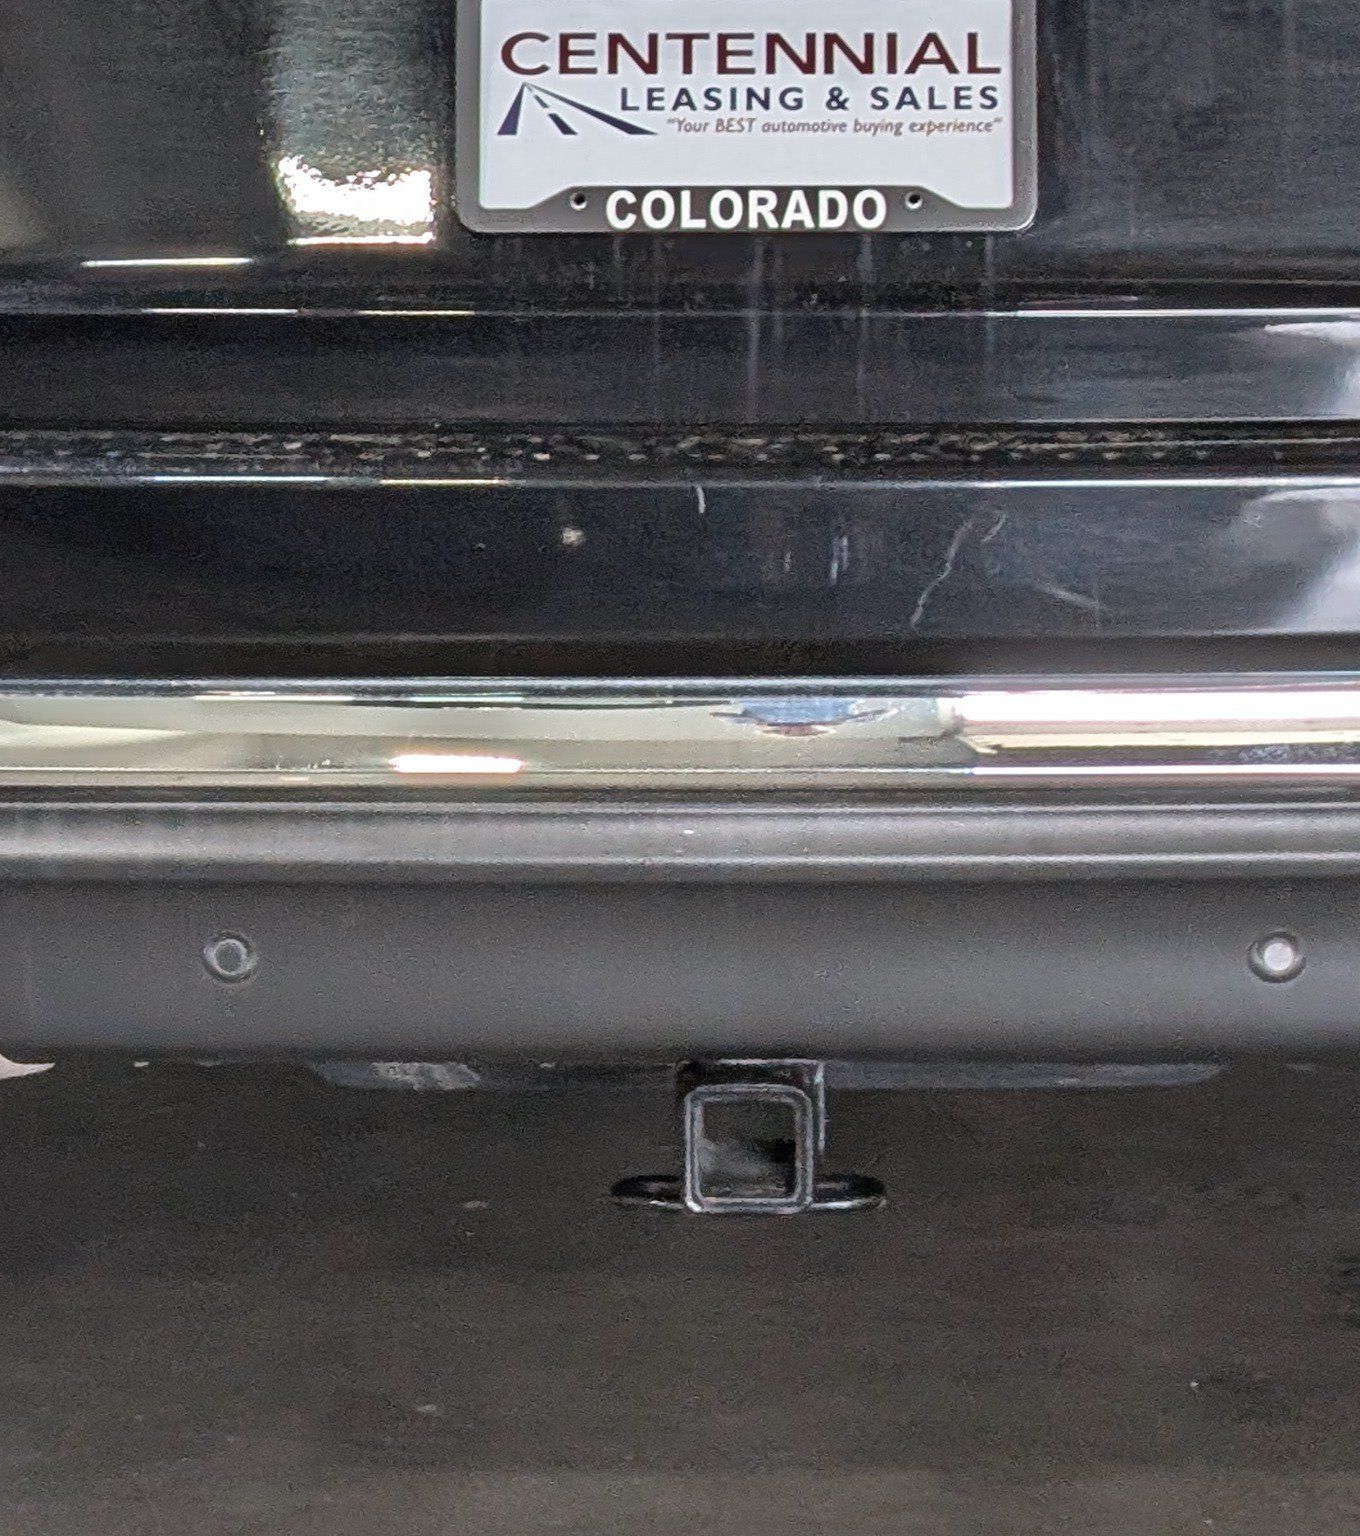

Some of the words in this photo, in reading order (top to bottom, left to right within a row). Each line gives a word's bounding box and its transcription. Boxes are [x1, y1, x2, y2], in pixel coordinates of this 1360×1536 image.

[501, 32, 1002, 75] CENTENNIAL
[621, 87, 805, 111] LEASING
[825, 87, 850, 111] &
[871, 86, 999, 110] SALES
[716, 118, 757, 133] BEST
[762, 119, 847, 133] automotive
[853, 118, 903, 138] buying
[605, 189, 888, 230] COLORADO
